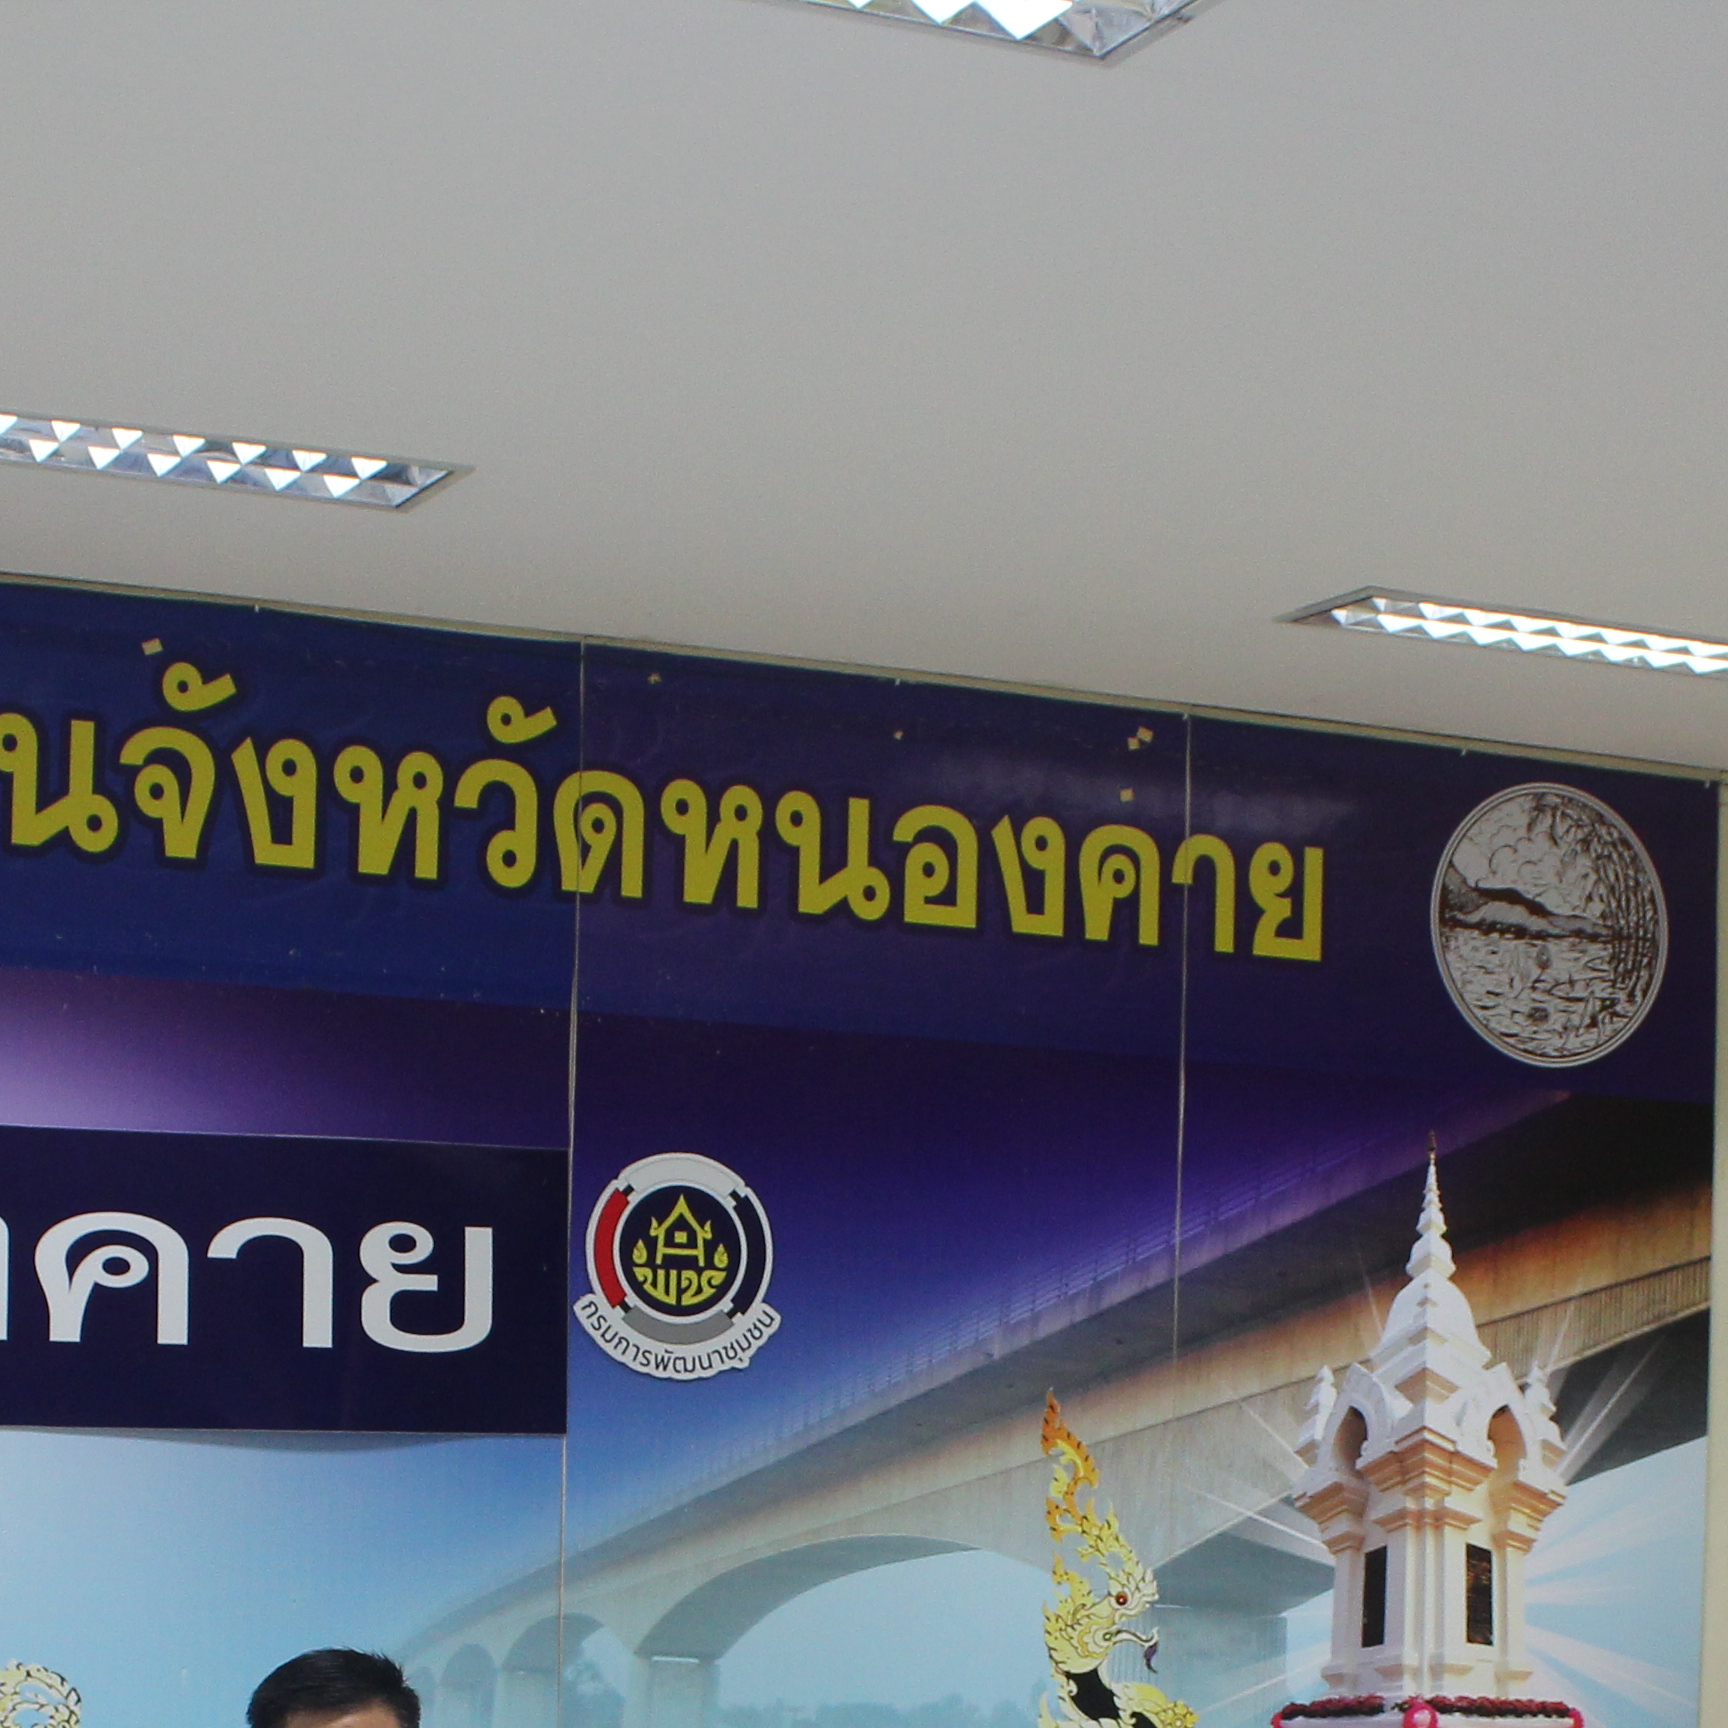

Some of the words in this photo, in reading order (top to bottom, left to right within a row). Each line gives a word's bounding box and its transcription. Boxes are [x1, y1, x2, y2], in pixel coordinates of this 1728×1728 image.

[580, 1300, 776, 1374] กรมการพัฒนาชุมชน
